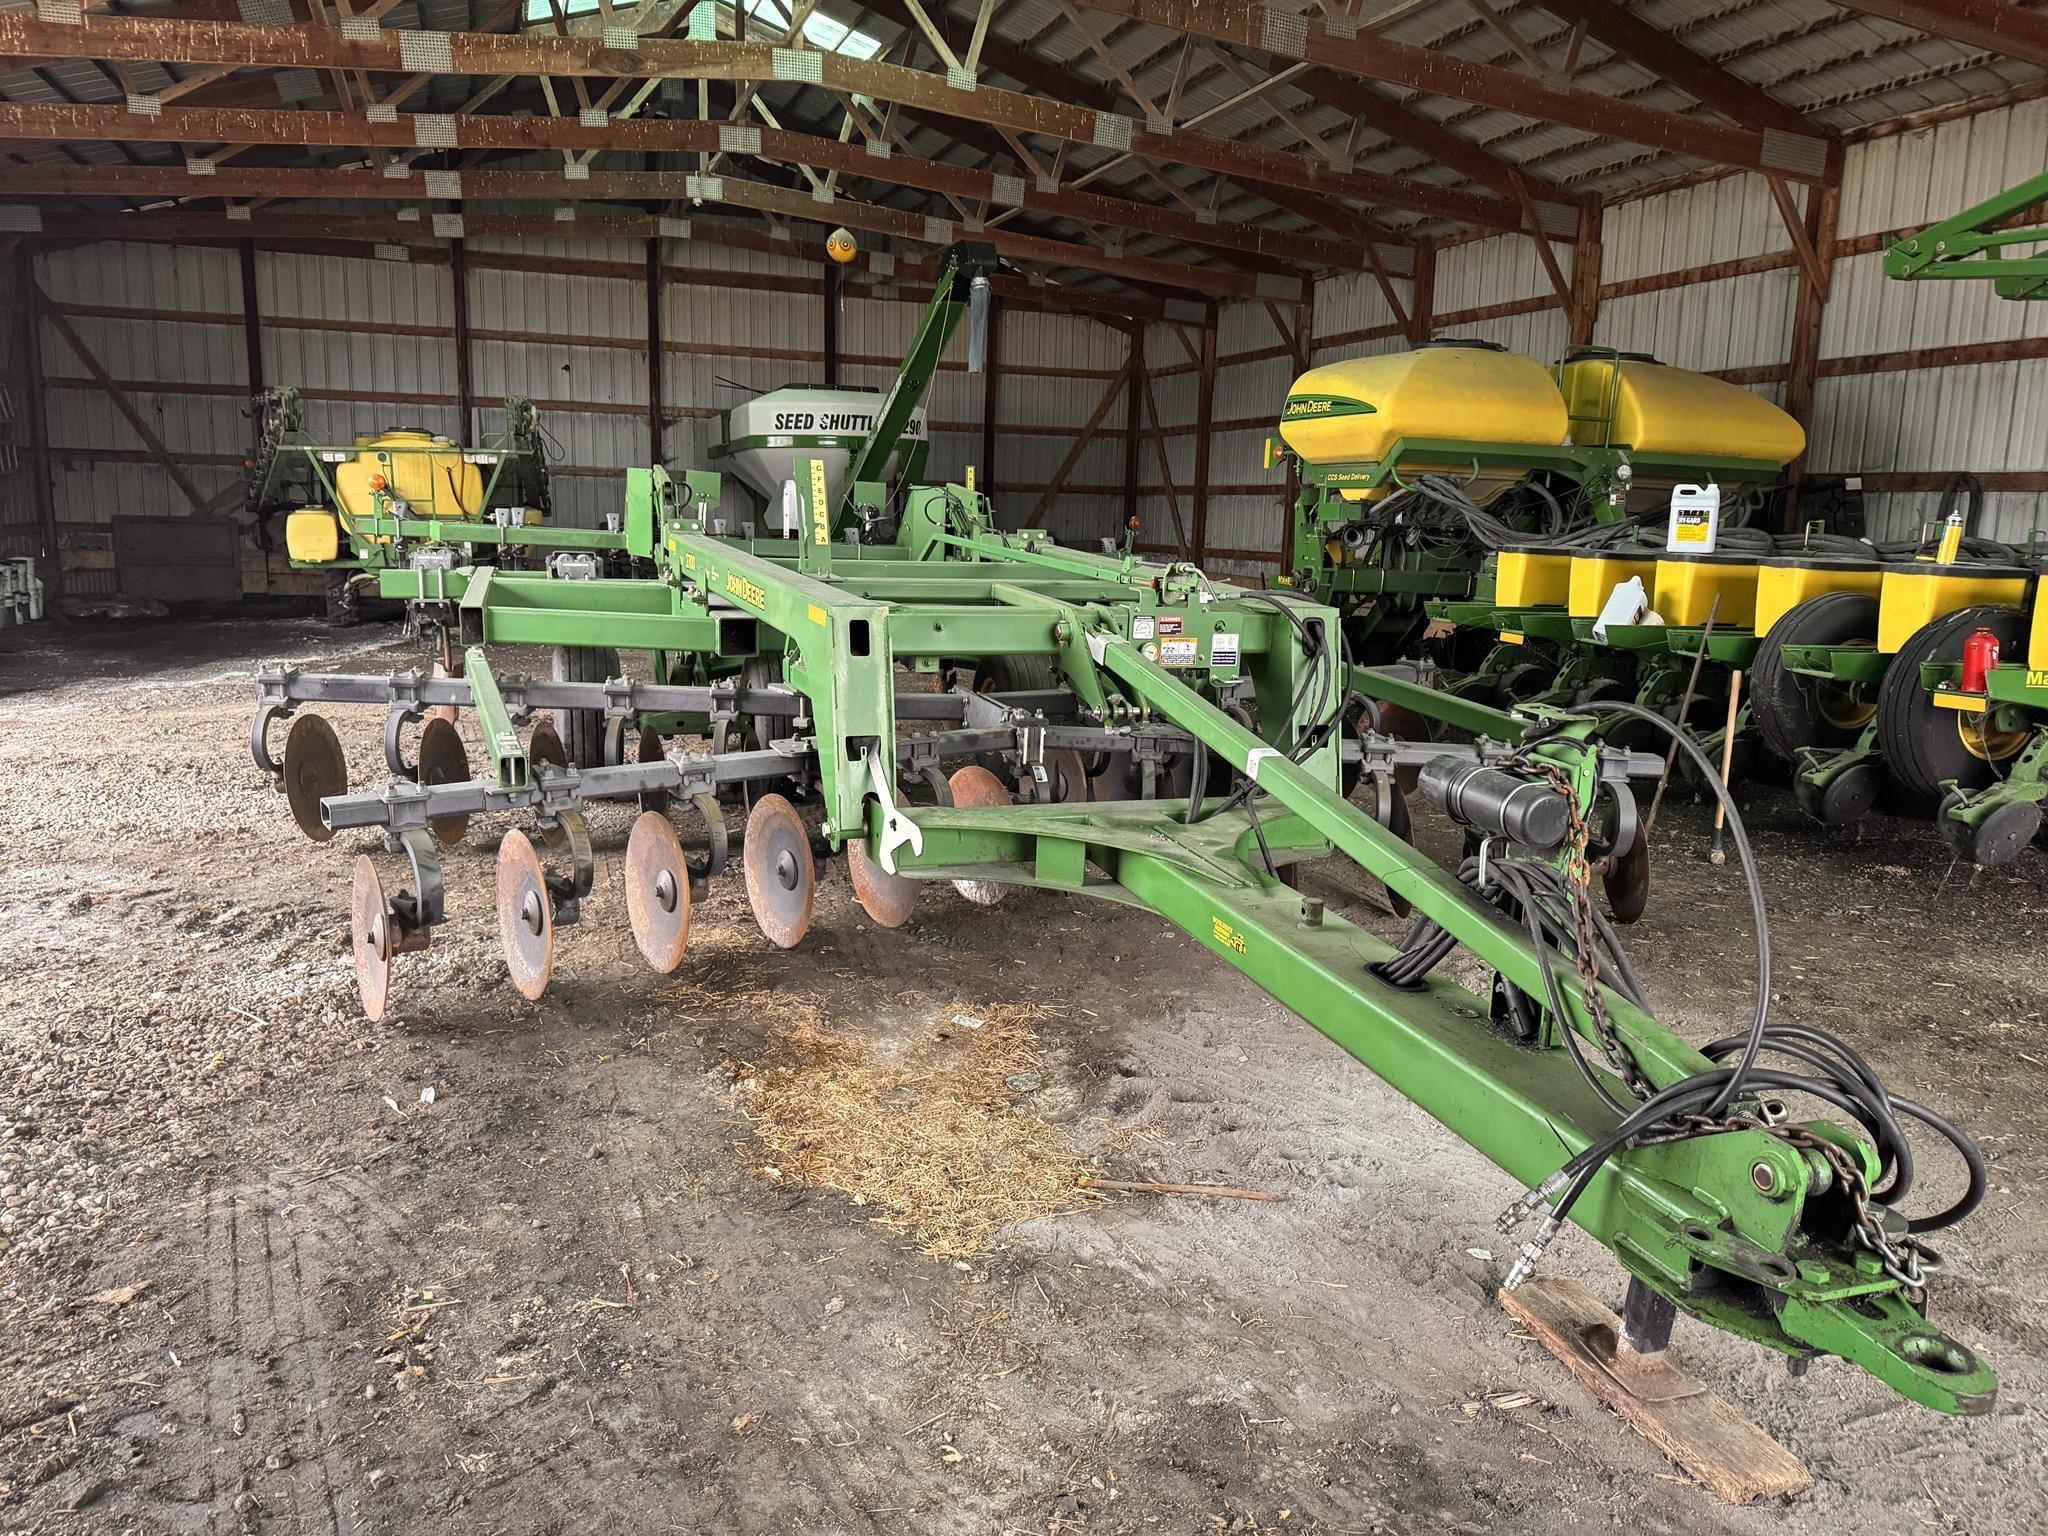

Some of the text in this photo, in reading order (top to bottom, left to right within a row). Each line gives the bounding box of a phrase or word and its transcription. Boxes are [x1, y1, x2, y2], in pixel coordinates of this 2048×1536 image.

[1287, 400, 1332, 415] JOHN DEERE
[775, 413, 873, 431] SEED SHUTTL
[1327, 473, 1371, 482] CCS Seed Delivery
[727, 570, 743, 598] JOHN
[742, 576, 765, 610] DEERE
